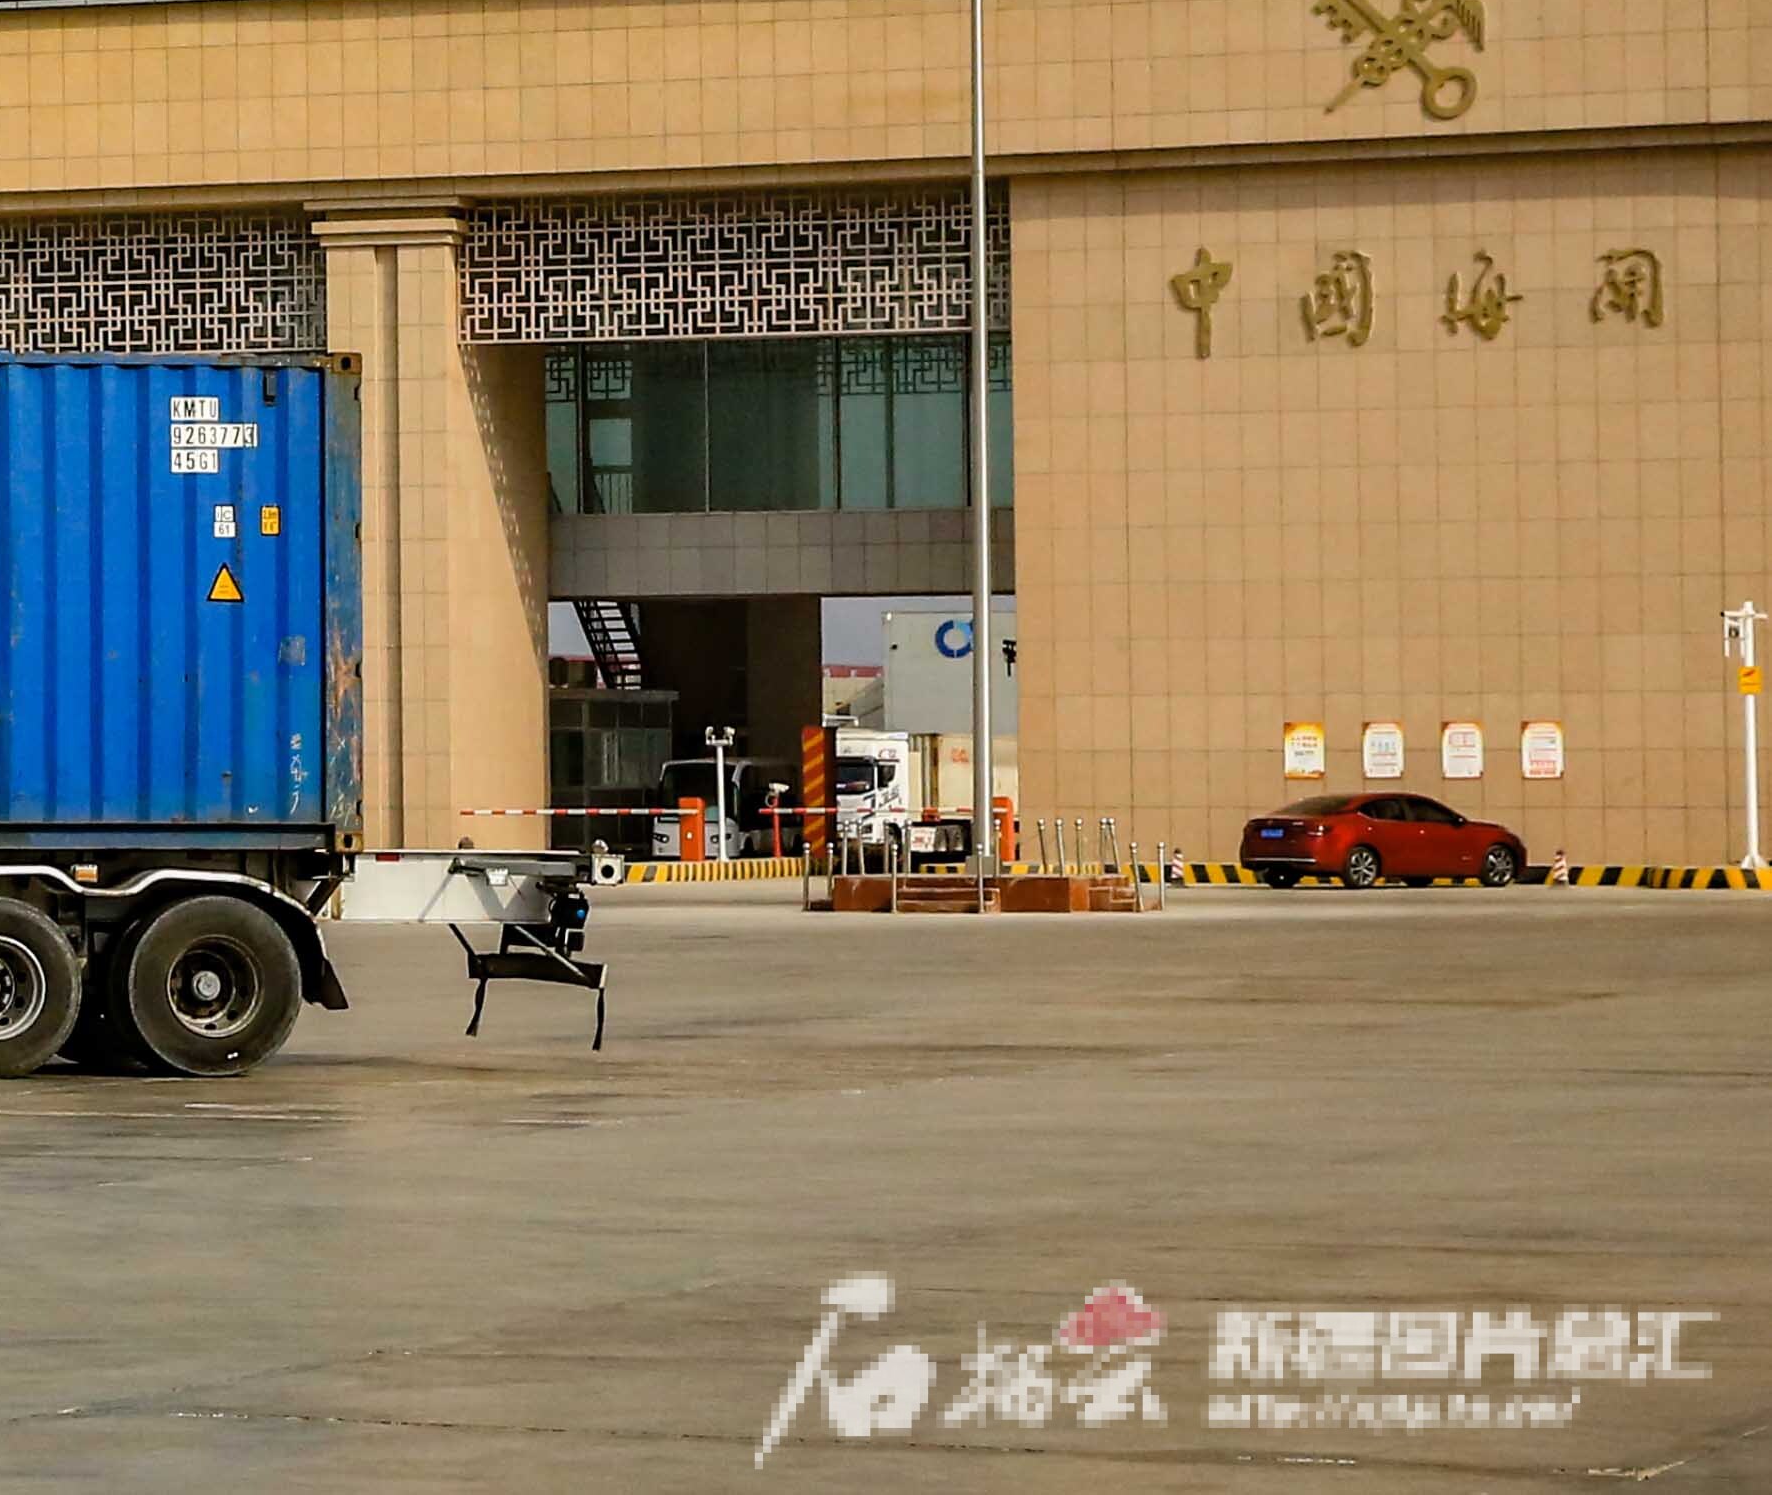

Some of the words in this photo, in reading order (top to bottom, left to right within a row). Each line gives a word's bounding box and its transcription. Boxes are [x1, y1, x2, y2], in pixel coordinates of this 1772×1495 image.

[172, 399, 217, 418] KMTU
[172, 426, 255, 445] 9263773
[173, 452, 217, 470] 45G1
